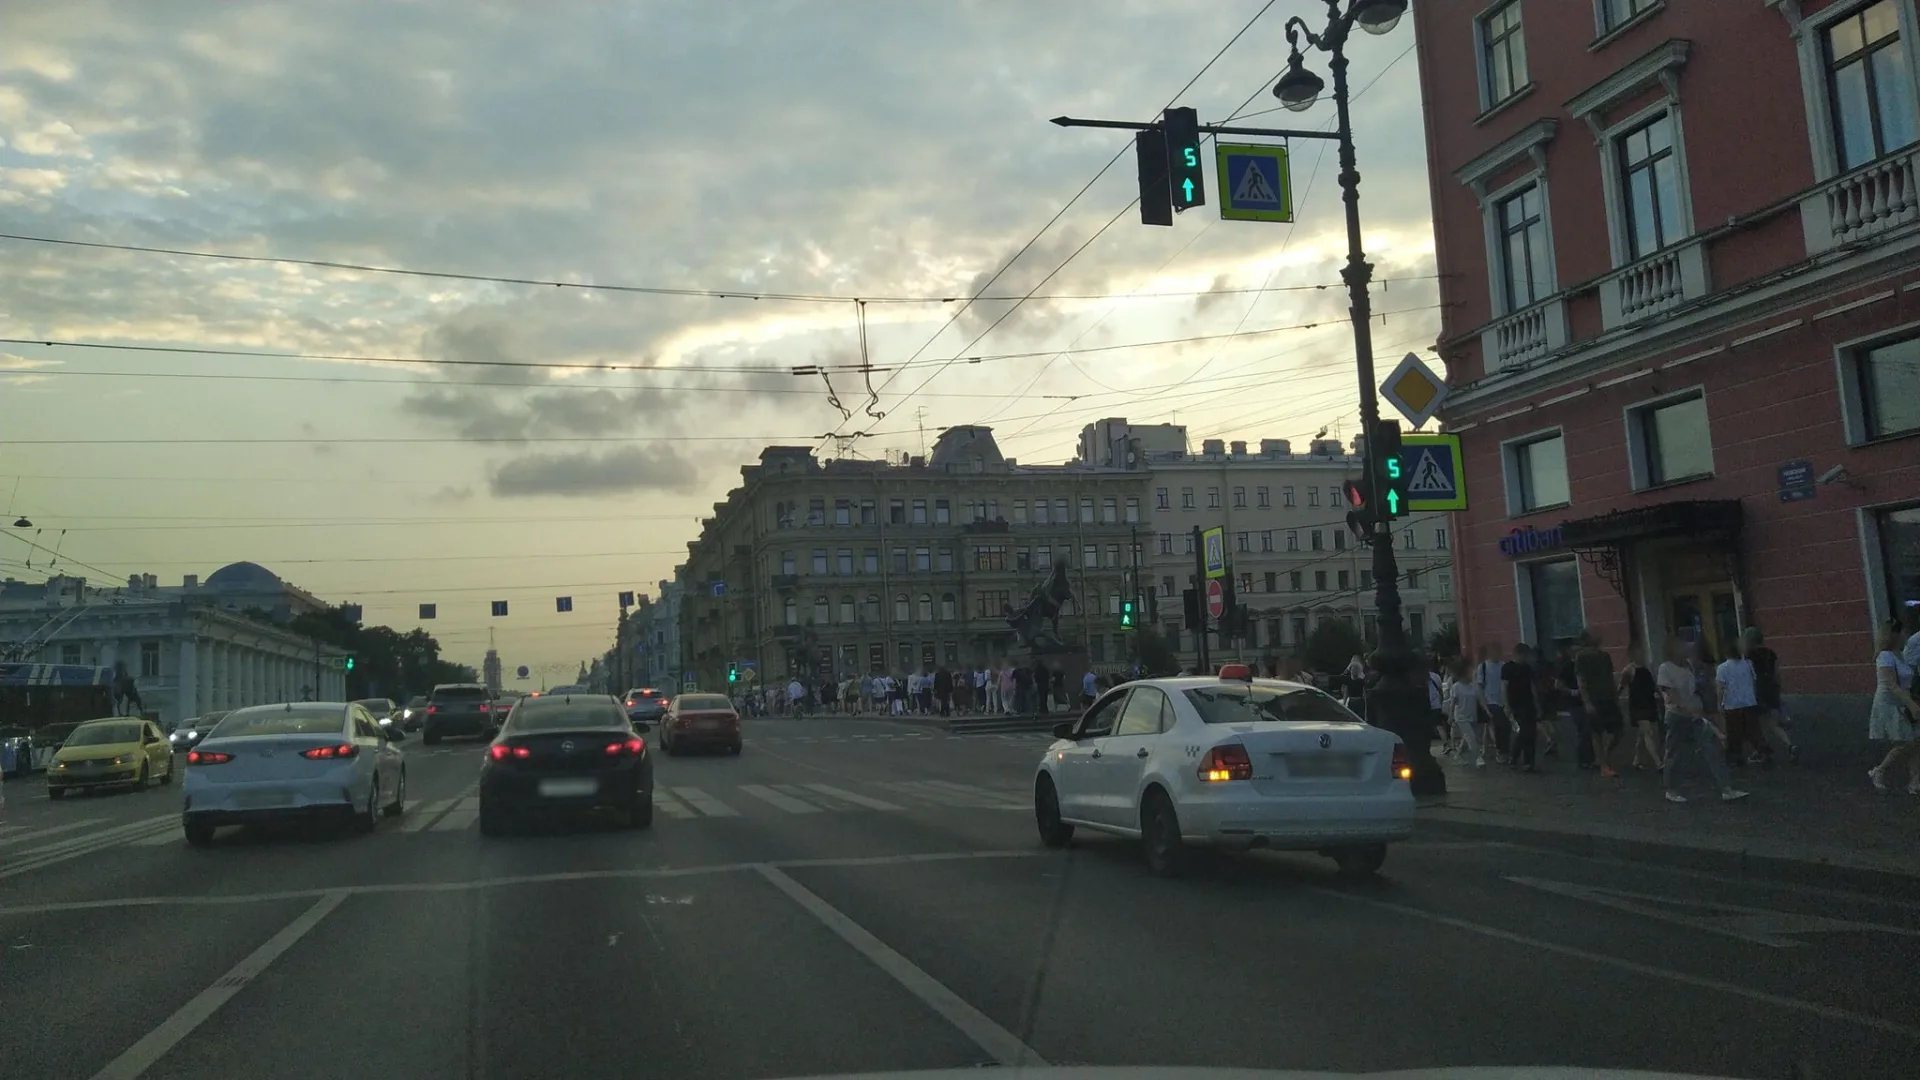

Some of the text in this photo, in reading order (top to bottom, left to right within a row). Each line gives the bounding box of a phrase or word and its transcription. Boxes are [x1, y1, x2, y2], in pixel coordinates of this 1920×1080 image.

[1184, 147, 1196, 167] 5
[1387, 458, 1400, 478] 5
[1498, 524, 1563, 557] citiban
